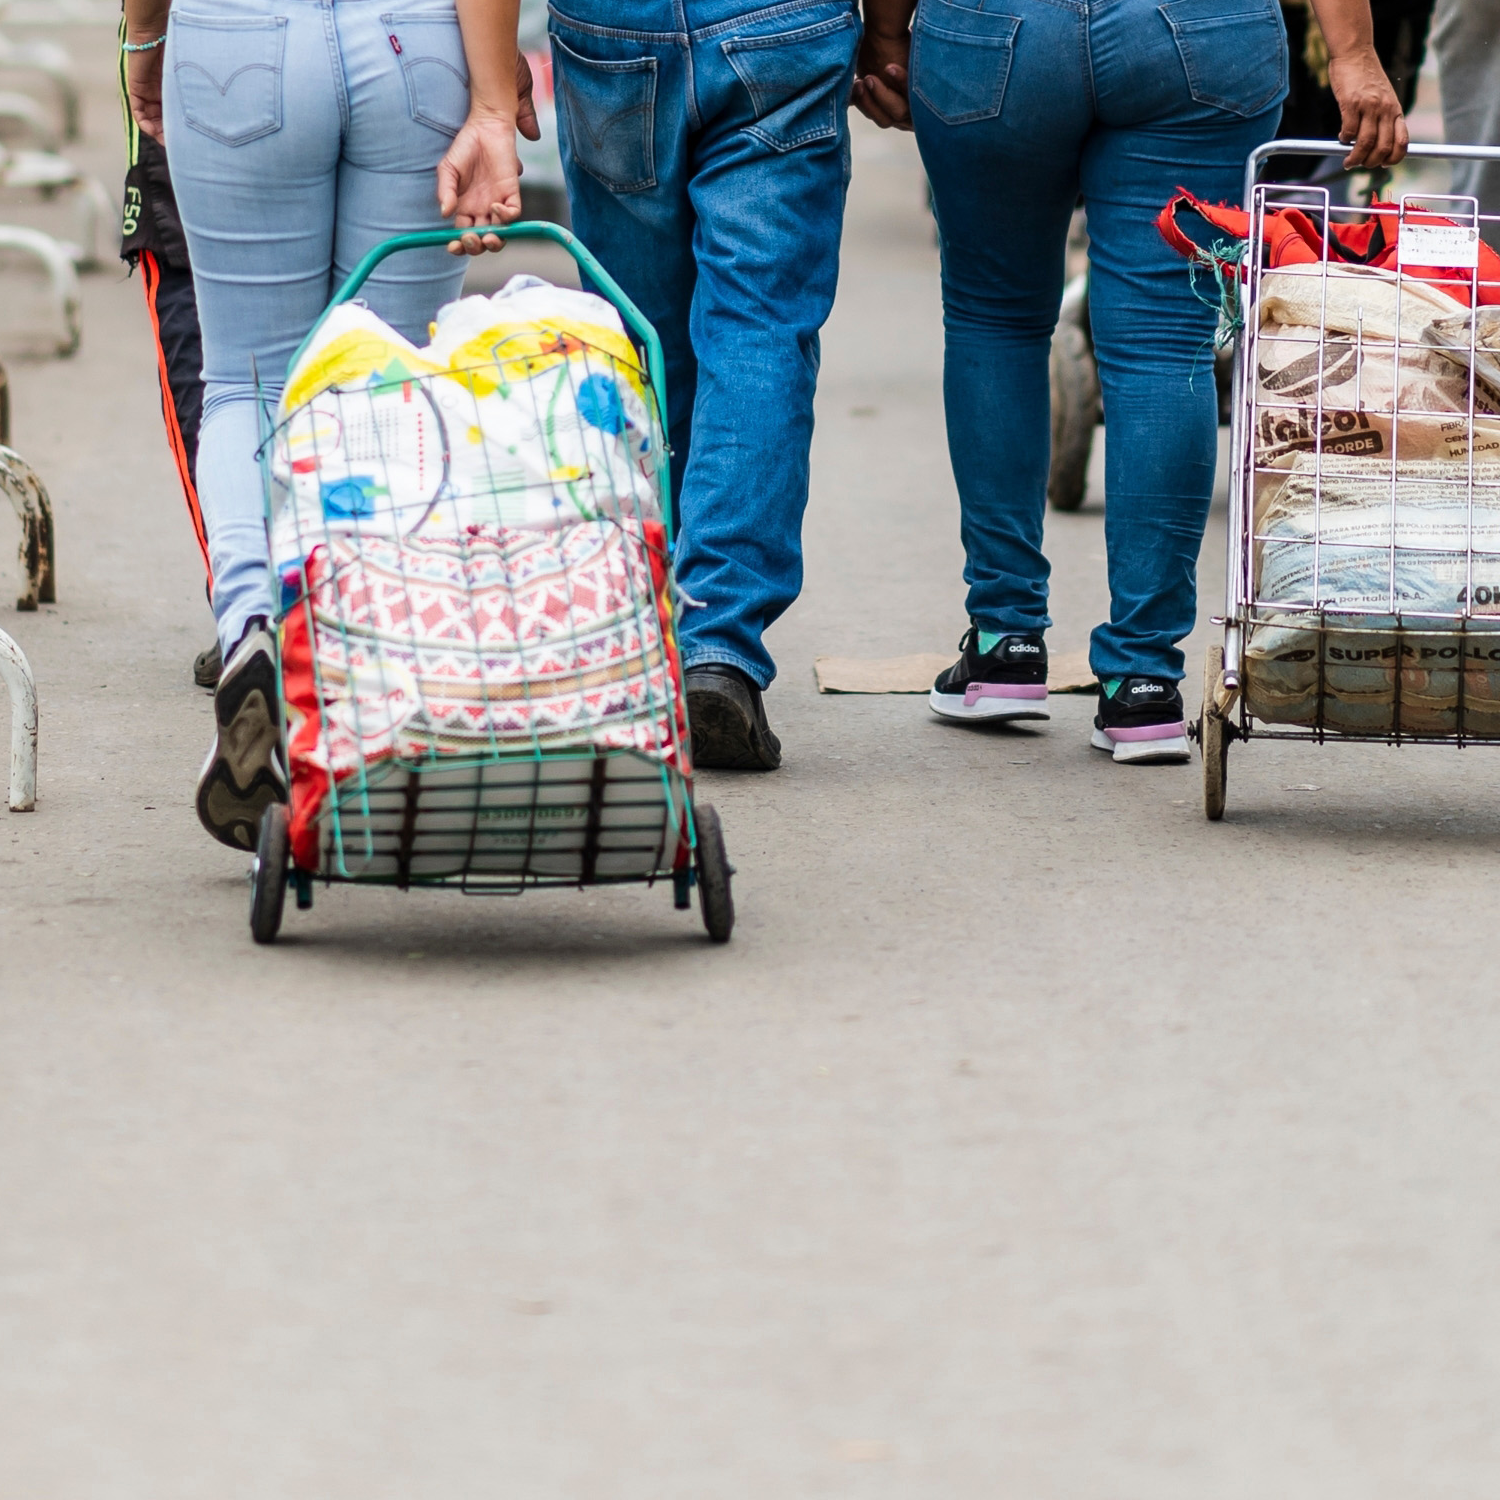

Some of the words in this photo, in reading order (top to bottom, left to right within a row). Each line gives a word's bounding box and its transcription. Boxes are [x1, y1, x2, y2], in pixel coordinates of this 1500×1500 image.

[123, 187, 142, 236] F50
[1009, 644, 1040, 653] adidas
[1329, 646, 1414, 661] SUPER
[1131, 684, 1164, 694] adidas
